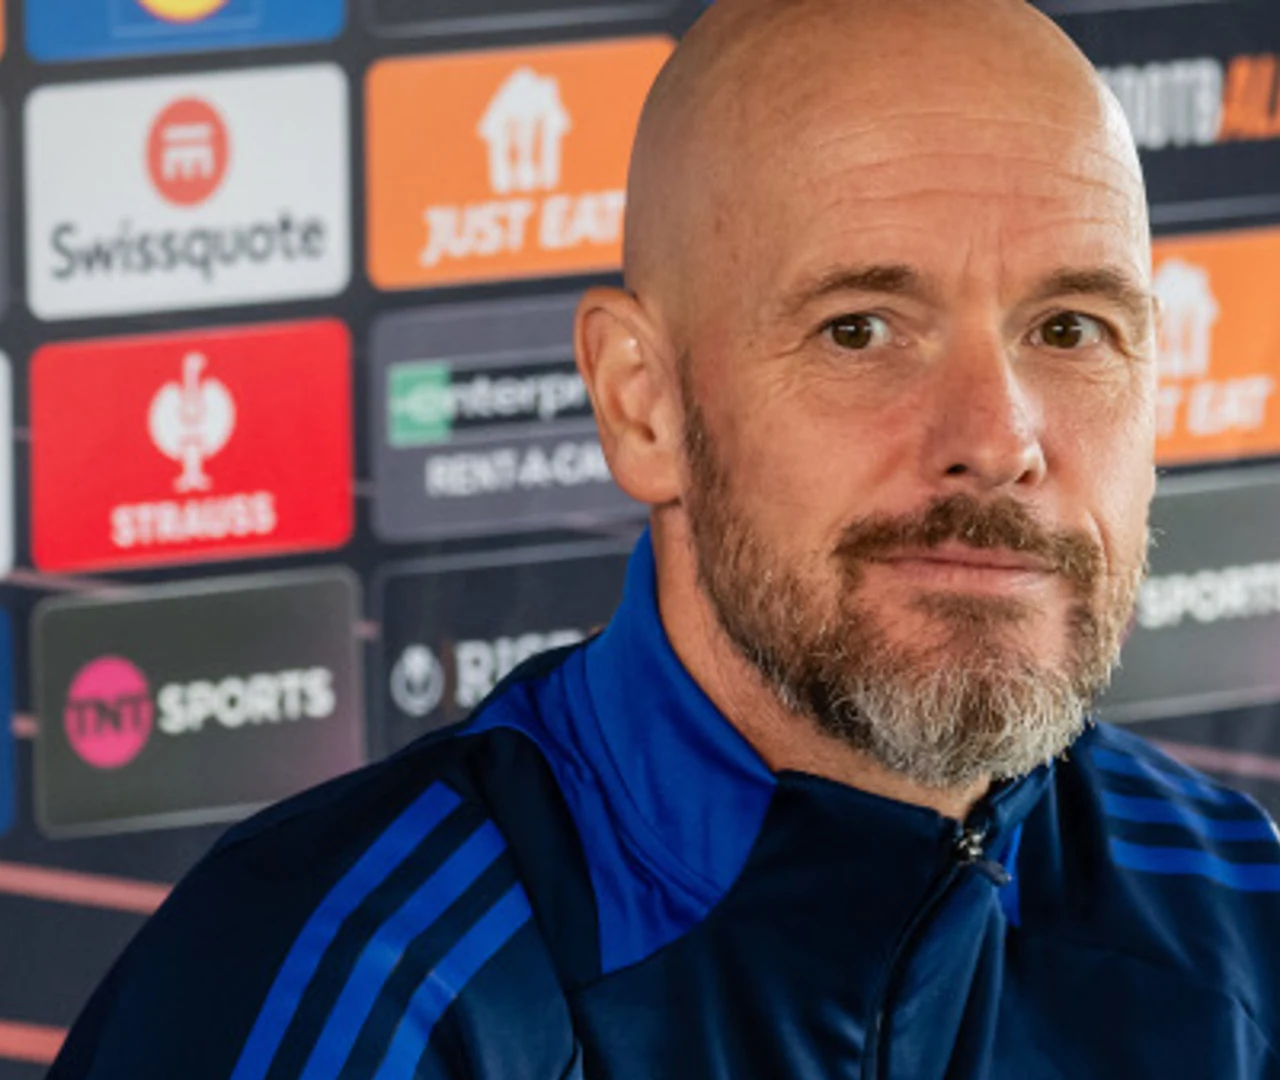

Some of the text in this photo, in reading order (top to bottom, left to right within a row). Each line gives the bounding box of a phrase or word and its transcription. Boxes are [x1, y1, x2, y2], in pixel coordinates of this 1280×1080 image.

[50, 211, 326, 279] Swissquote
[418, 189, 627, 268] JUST EAT
[1186, 374, 1277, 436] EAT
[109, 490, 277, 549] STRAUSS
[156, 666, 337, 735] SPORTS
